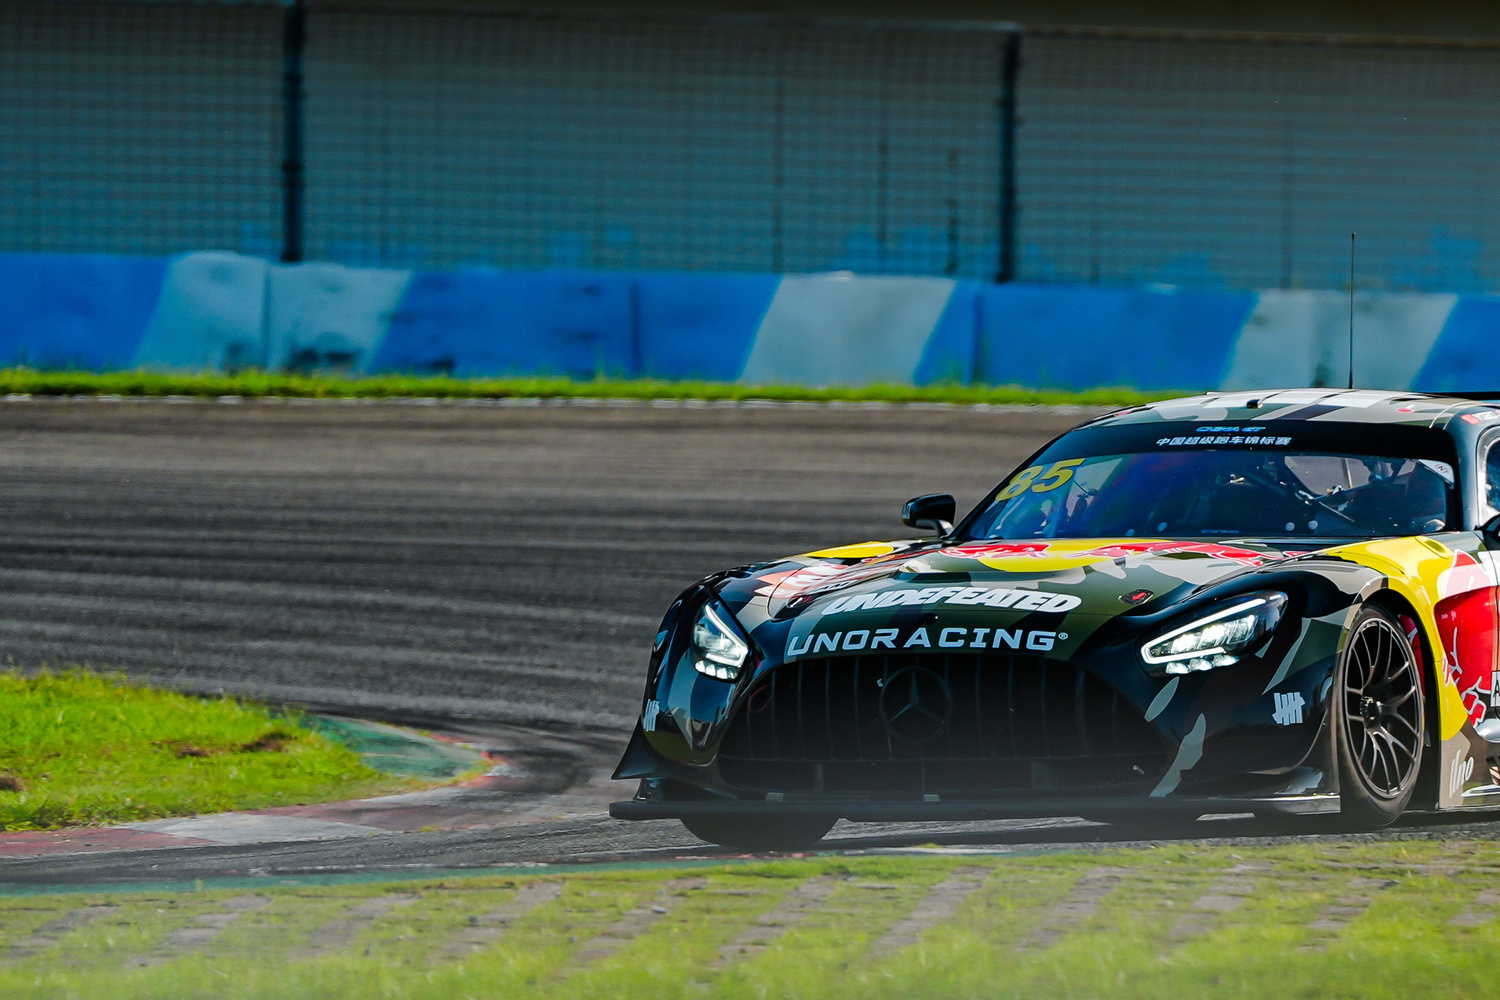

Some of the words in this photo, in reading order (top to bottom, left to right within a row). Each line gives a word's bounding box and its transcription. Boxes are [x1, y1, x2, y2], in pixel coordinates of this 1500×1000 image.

[1156, 436, 1292, 446] 中国超级跑车锦标赛
[995, 458, 1086, 501] 85
[821, 586, 1082, 615] UNDEFEATED
